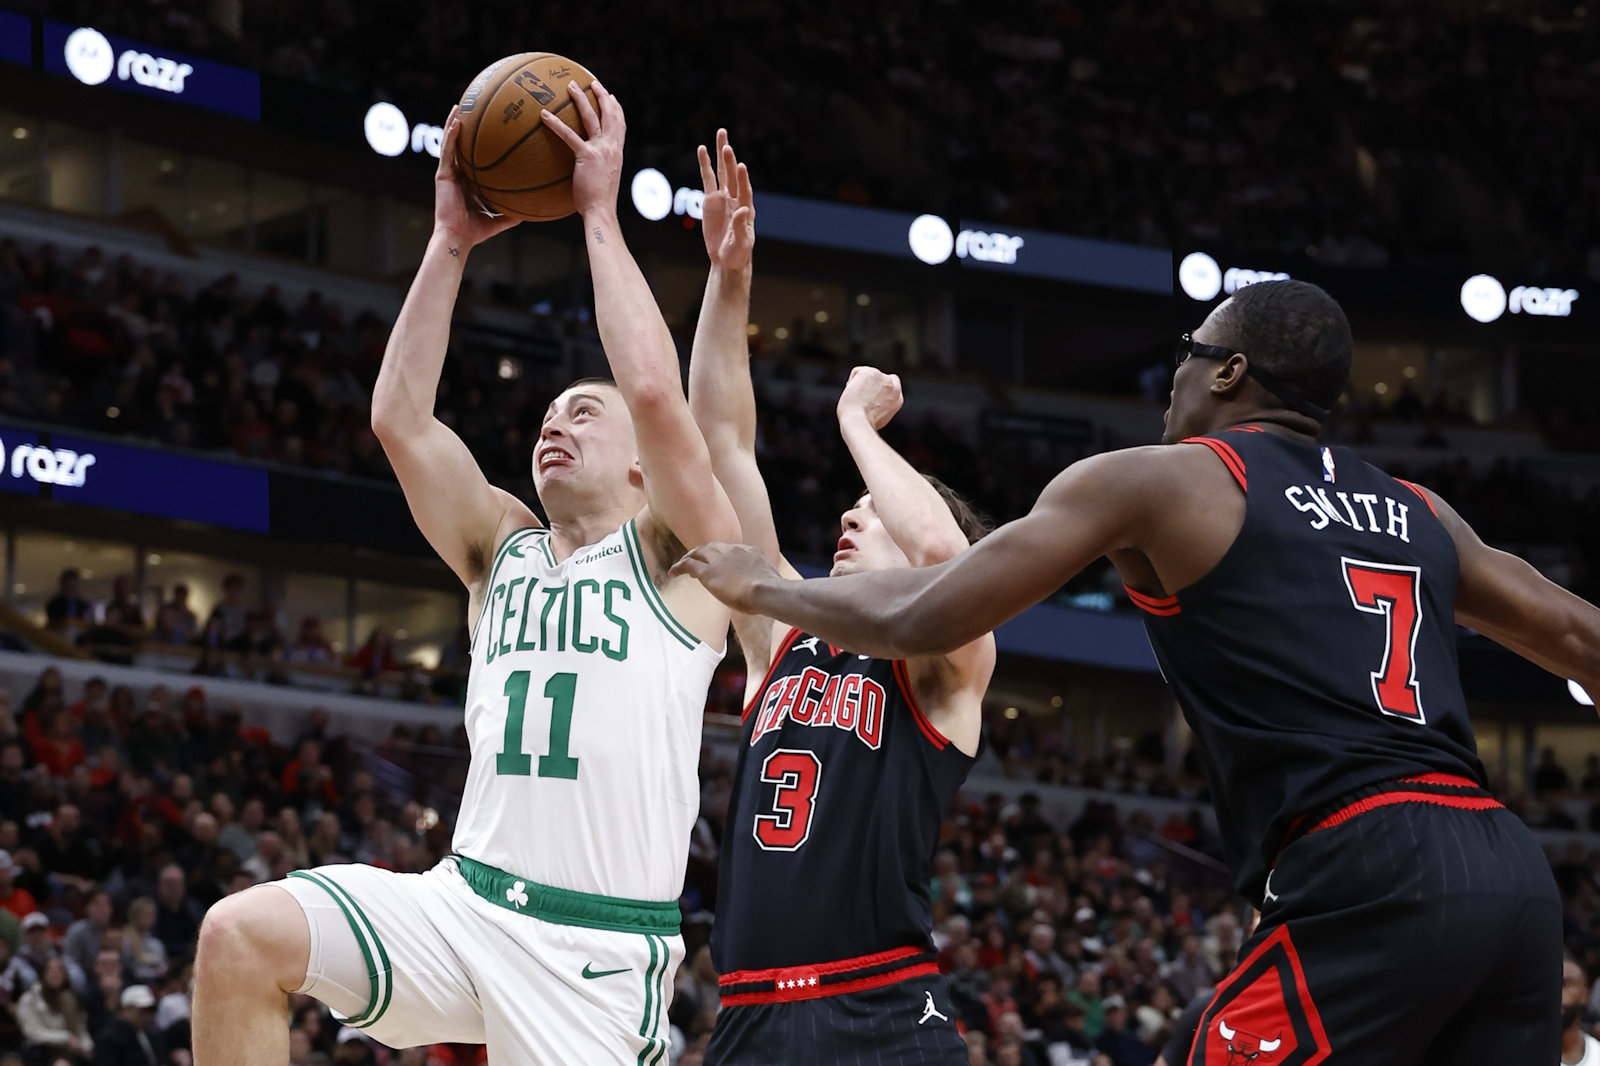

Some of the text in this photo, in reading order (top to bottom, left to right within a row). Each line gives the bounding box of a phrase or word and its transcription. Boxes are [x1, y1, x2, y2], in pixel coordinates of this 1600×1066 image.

[117, 49, 193, 94] razr
[411, 122, 444, 159] ra
[673, 186, 705, 220] ra
[955, 229, 1024, 264] razr
[1508, 285, 1579, 316] razr
[11, 443, 96, 487] razr
[1285, 485, 1410, 543] SMITH
[575, 544, 623, 565] Amica
[487, 576, 632, 665] CELTICS
[1341, 556, 1426, 725] 7
[496, 670, 579, 780] 11
[750, 665, 886, 750] CHCAGO
[753, 748, 822, 851] 3
